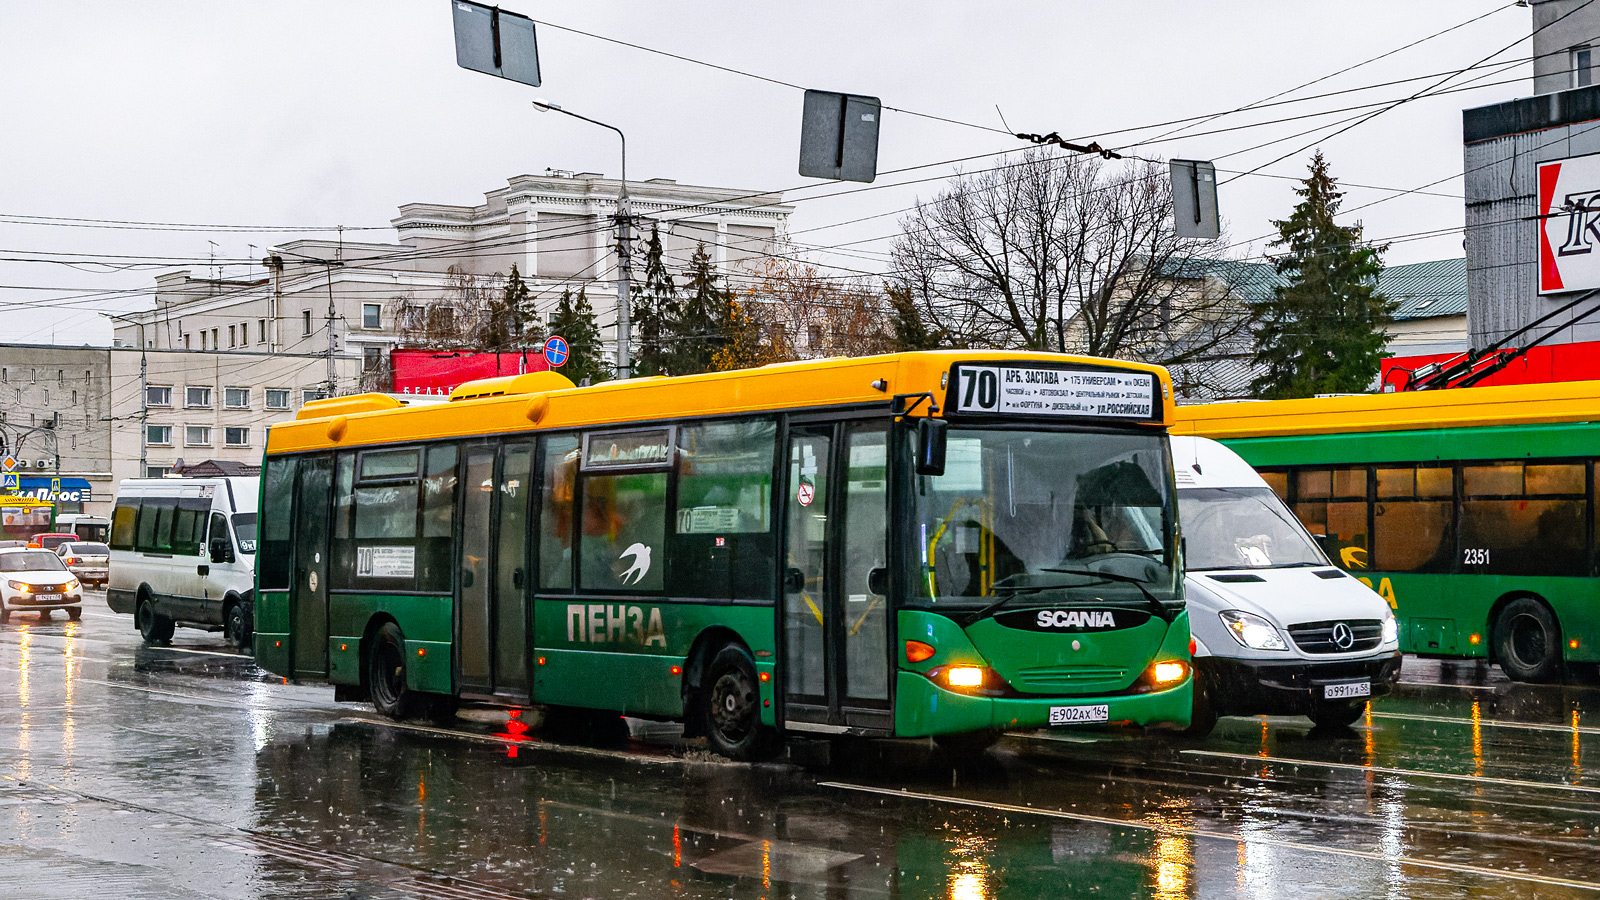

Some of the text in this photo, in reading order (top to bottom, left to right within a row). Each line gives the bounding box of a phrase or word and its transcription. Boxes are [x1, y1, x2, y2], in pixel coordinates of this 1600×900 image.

[1005, 370, 1023, 383] АРБ.
[1025, 371, 1060, 385] ЗАСТАВА
[1070, 375, 1081, 385] 175
[1081, 376, 1117, 386] УНИВЕРСАМ
[1132, 378, 1150, 387] ОКЕАН
[961, 369, 997, 409] 70
[1020, 401, 1043, 409] ФОРТУНА
[359, 549, 372, 574] 70
[1464, 548, 1490, 565] 2351
[567, 604, 667, 648] ПЕНЗА
[1036, 610, 1116, 628] SCANIA
[1360, 683, 1369, 692] 58
[1092, 706, 1107, 716] 164
